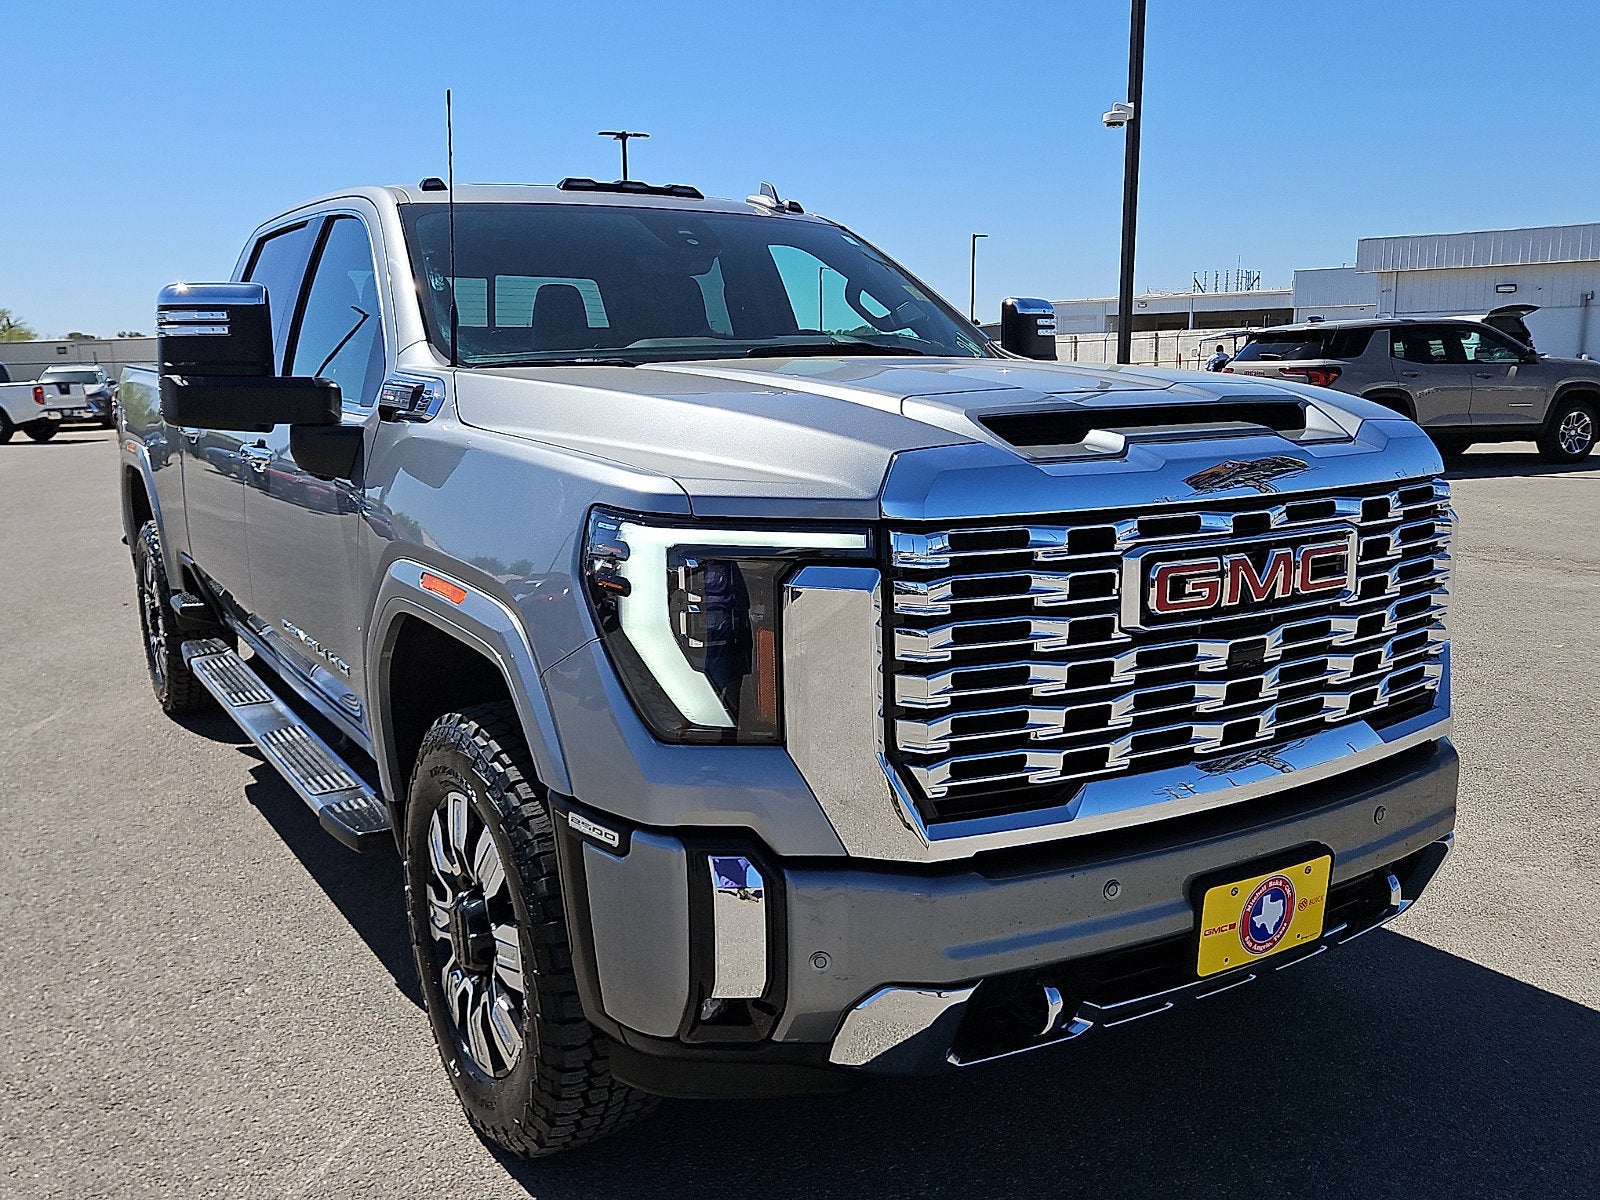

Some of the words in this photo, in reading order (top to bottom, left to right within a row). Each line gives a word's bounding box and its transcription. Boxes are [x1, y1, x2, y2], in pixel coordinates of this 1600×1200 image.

[1149, 539, 1350, 614] GMC
[569, 815, 617, 843] 2500
[1246, 884, 1267, 912] Mitchell
[1268, 879, 1283, 888] Buick
[1284, 884, 1292, 899] GMC
[1203, 924, 1228, 936] GMC
[1244, 935, 1253, 948] San
[1273, 922, 1288, 942] Texas
